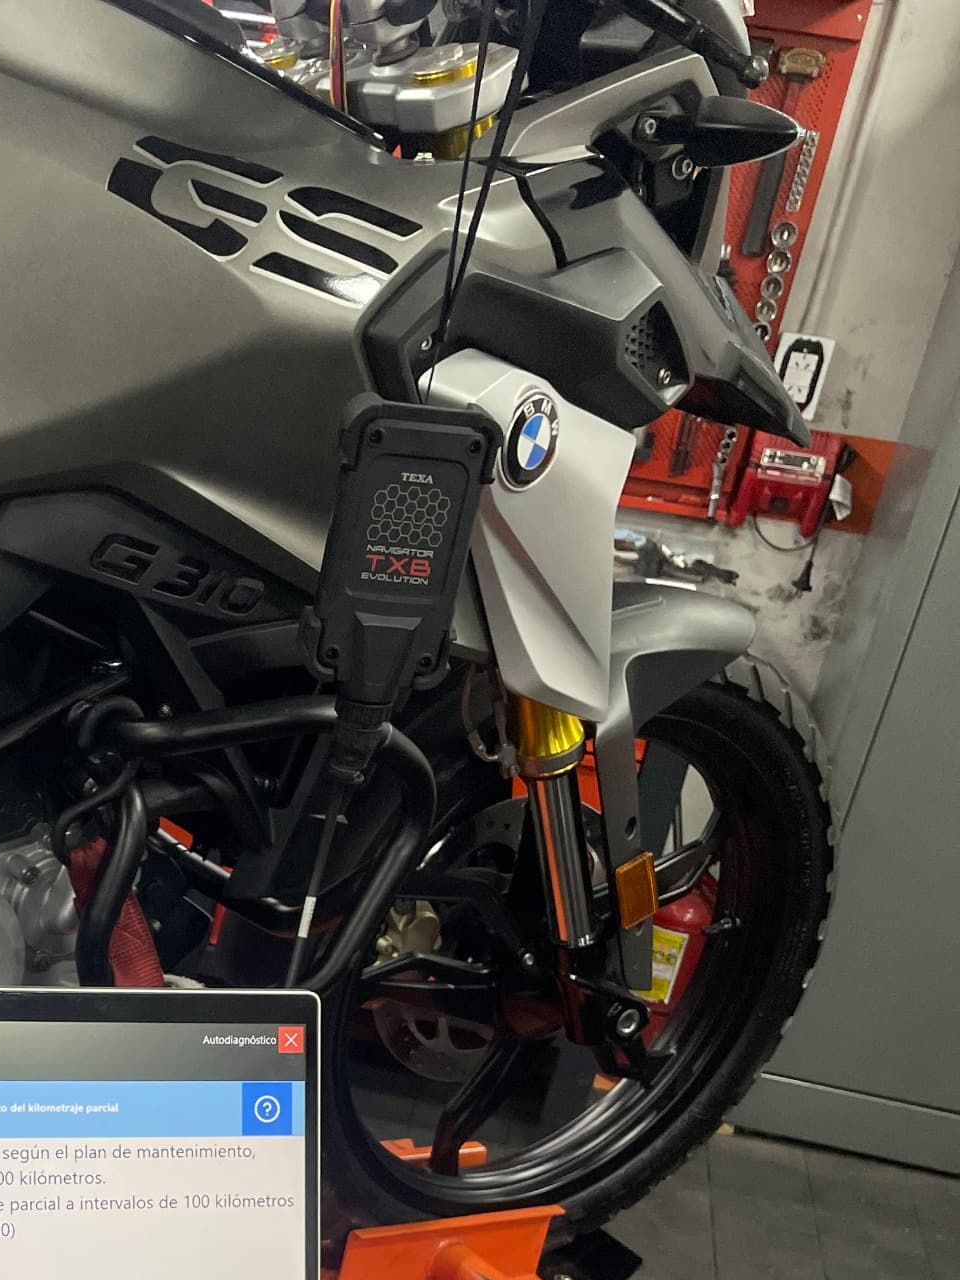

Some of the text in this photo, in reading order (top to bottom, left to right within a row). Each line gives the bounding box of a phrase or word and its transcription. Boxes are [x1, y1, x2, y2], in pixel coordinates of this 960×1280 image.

[523, 399, 559, 436] BMW
[401, 472, 434, 485] TEXA
[90, 532, 160, 586] G
[366, 544, 434, 559] NAVIGATOR
[361, 572, 429, 585] EVOLUTION
[202, 1034, 277, 1047] Autodiagnóstico
[10, 1103, 26, 1113] del
[28, 1103, 83, 1115] kilometraje
[86, 1103, 119, 1115] parcial
[2, 1144, 50, 1164] según
[55, 1145, 69, 1161] el
[73, 1144, 107, 1164] plan
[112, 1144, 132, 1160] de
[137, 1144, 256, 1161] mantenimiento,
[19, 1169, 106, 1186] kilómetros.
[10, 1195, 60, 1214] parcial
[66, 1199, 75, 1211] a
[79, 1194, 153, 1212] intervalos
[158, 1193, 178, 1210] de
[183, 1194, 210, 1209] 100
[215, 1192, 294, 1209] kilómetros
